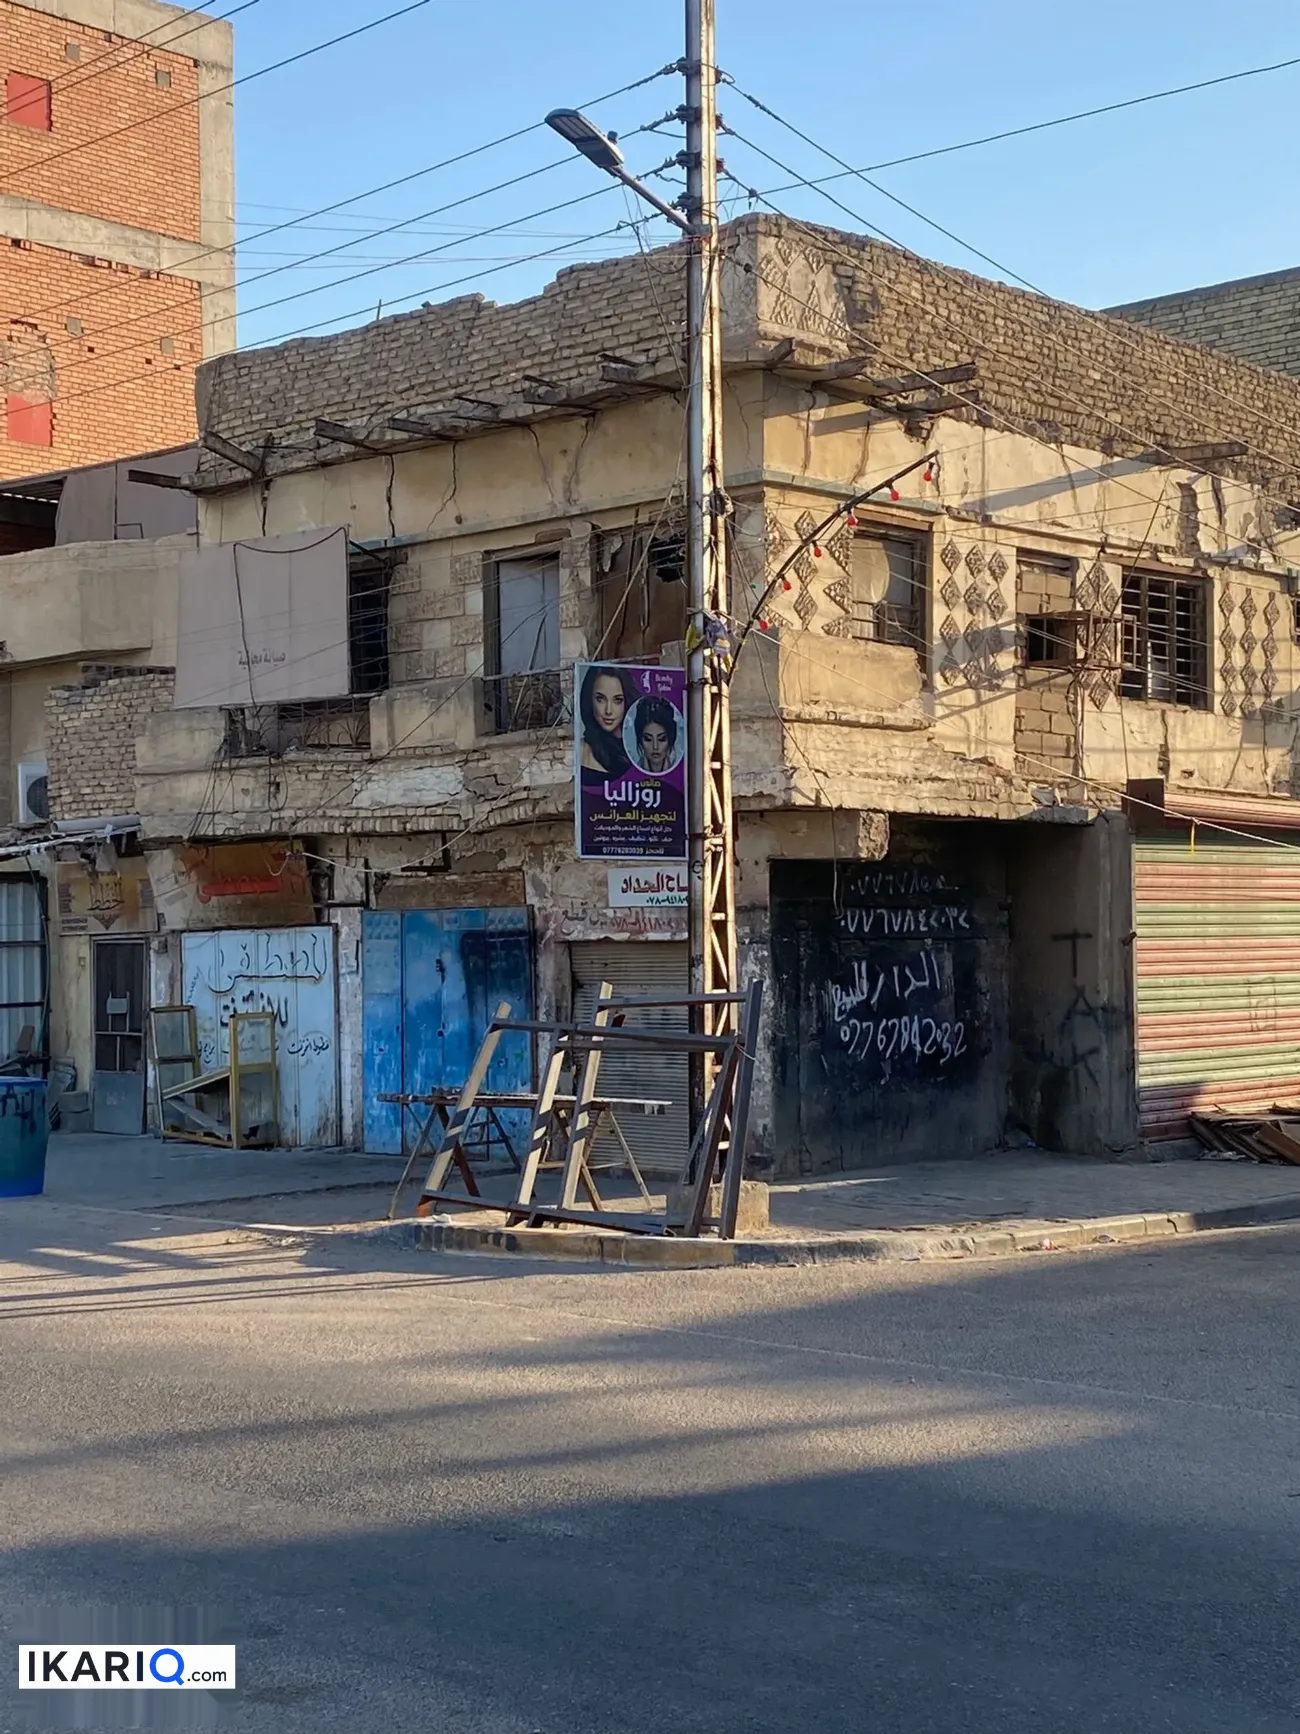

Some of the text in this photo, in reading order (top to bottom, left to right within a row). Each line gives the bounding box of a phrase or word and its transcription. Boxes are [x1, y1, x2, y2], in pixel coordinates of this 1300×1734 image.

[604, 780, 661, 808] روزاليا
[589, 808, 677, 825] لتجهيز العرائس
[620, 871, 688, 894] اح الحداد
[833, 950, 941, 1022] الدار للبيع
